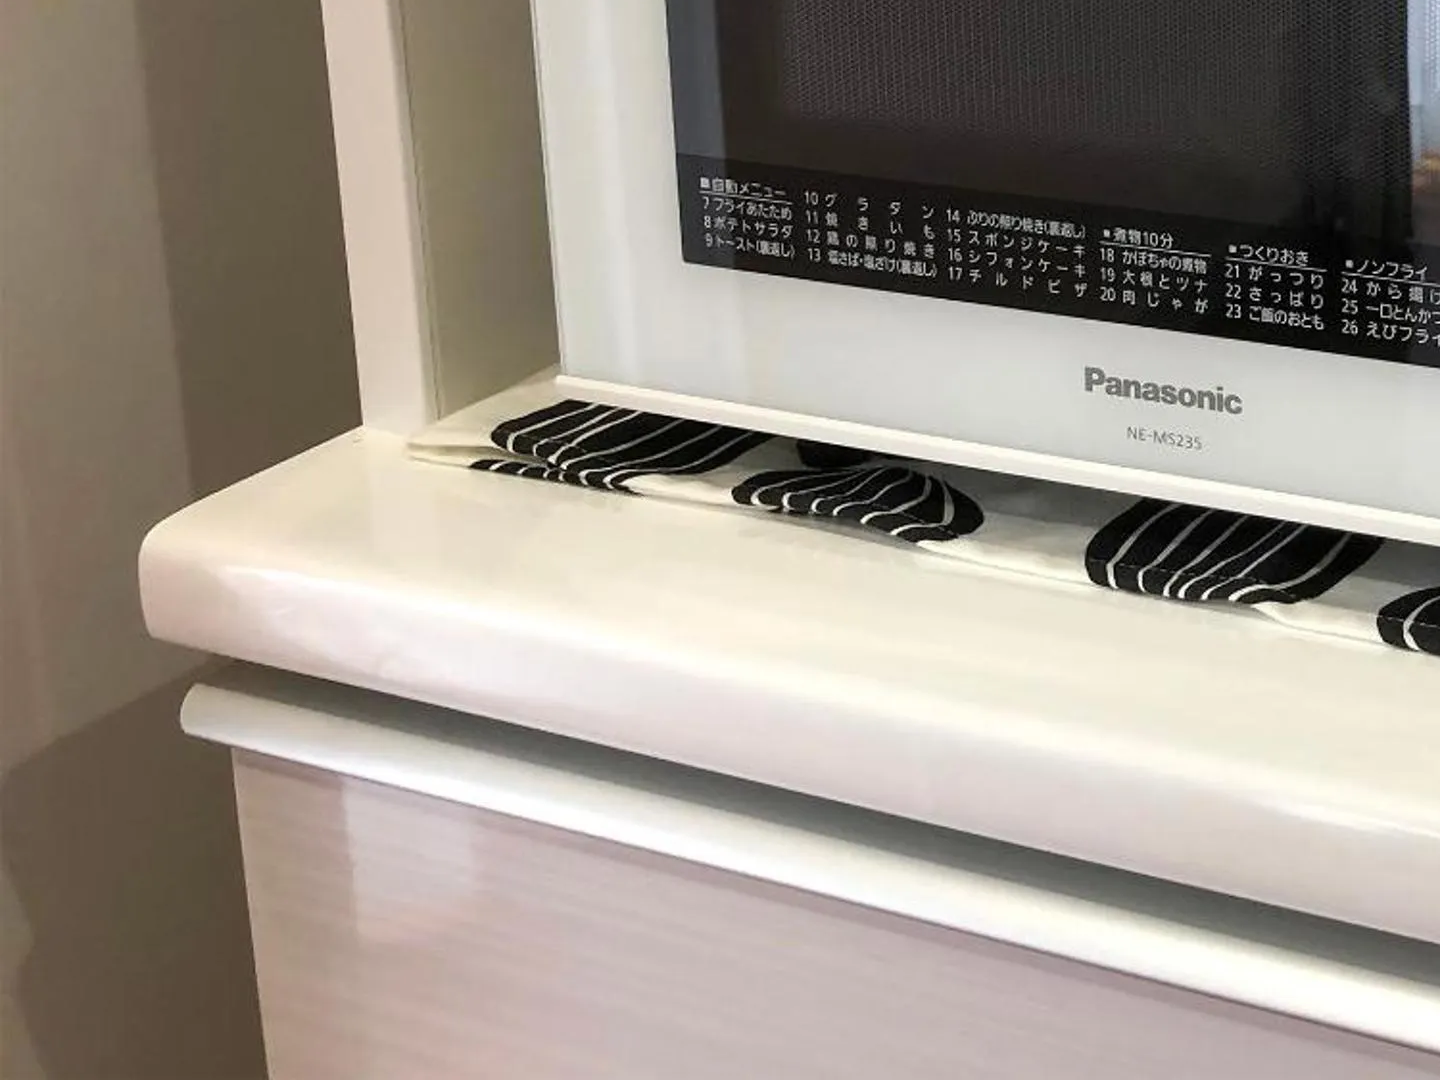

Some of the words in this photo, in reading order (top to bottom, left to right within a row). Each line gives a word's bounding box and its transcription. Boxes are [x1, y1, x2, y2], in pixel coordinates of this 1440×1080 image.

[804, 190, 819, 205] 10
[805, 210, 819, 225] 11
[946, 208, 960, 224] 14
[806, 229, 821, 244] 12
[947, 228, 961, 243] 15
[808, 248, 821, 263] 13
[948, 248, 963, 262] 16
[1100, 248, 1115, 263] 18
[948, 266, 963, 281] 17
[1101, 267, 1115, 283] 19
[1225, 263, 1240, 279] 21
[1100, 286, 1116, 302] 20
[1225, 283, 1241, 299] 22
[1341, 278, 1358, 295] 24
[1226, 303, 1242, 319] 23
[1341, 298, 1358, 315] 25
[1341, 318, 1358, 335] 26
[1084, 366, 1243, 415] Panasonic
[1125, 426, 1203, 450] NE-MS235
